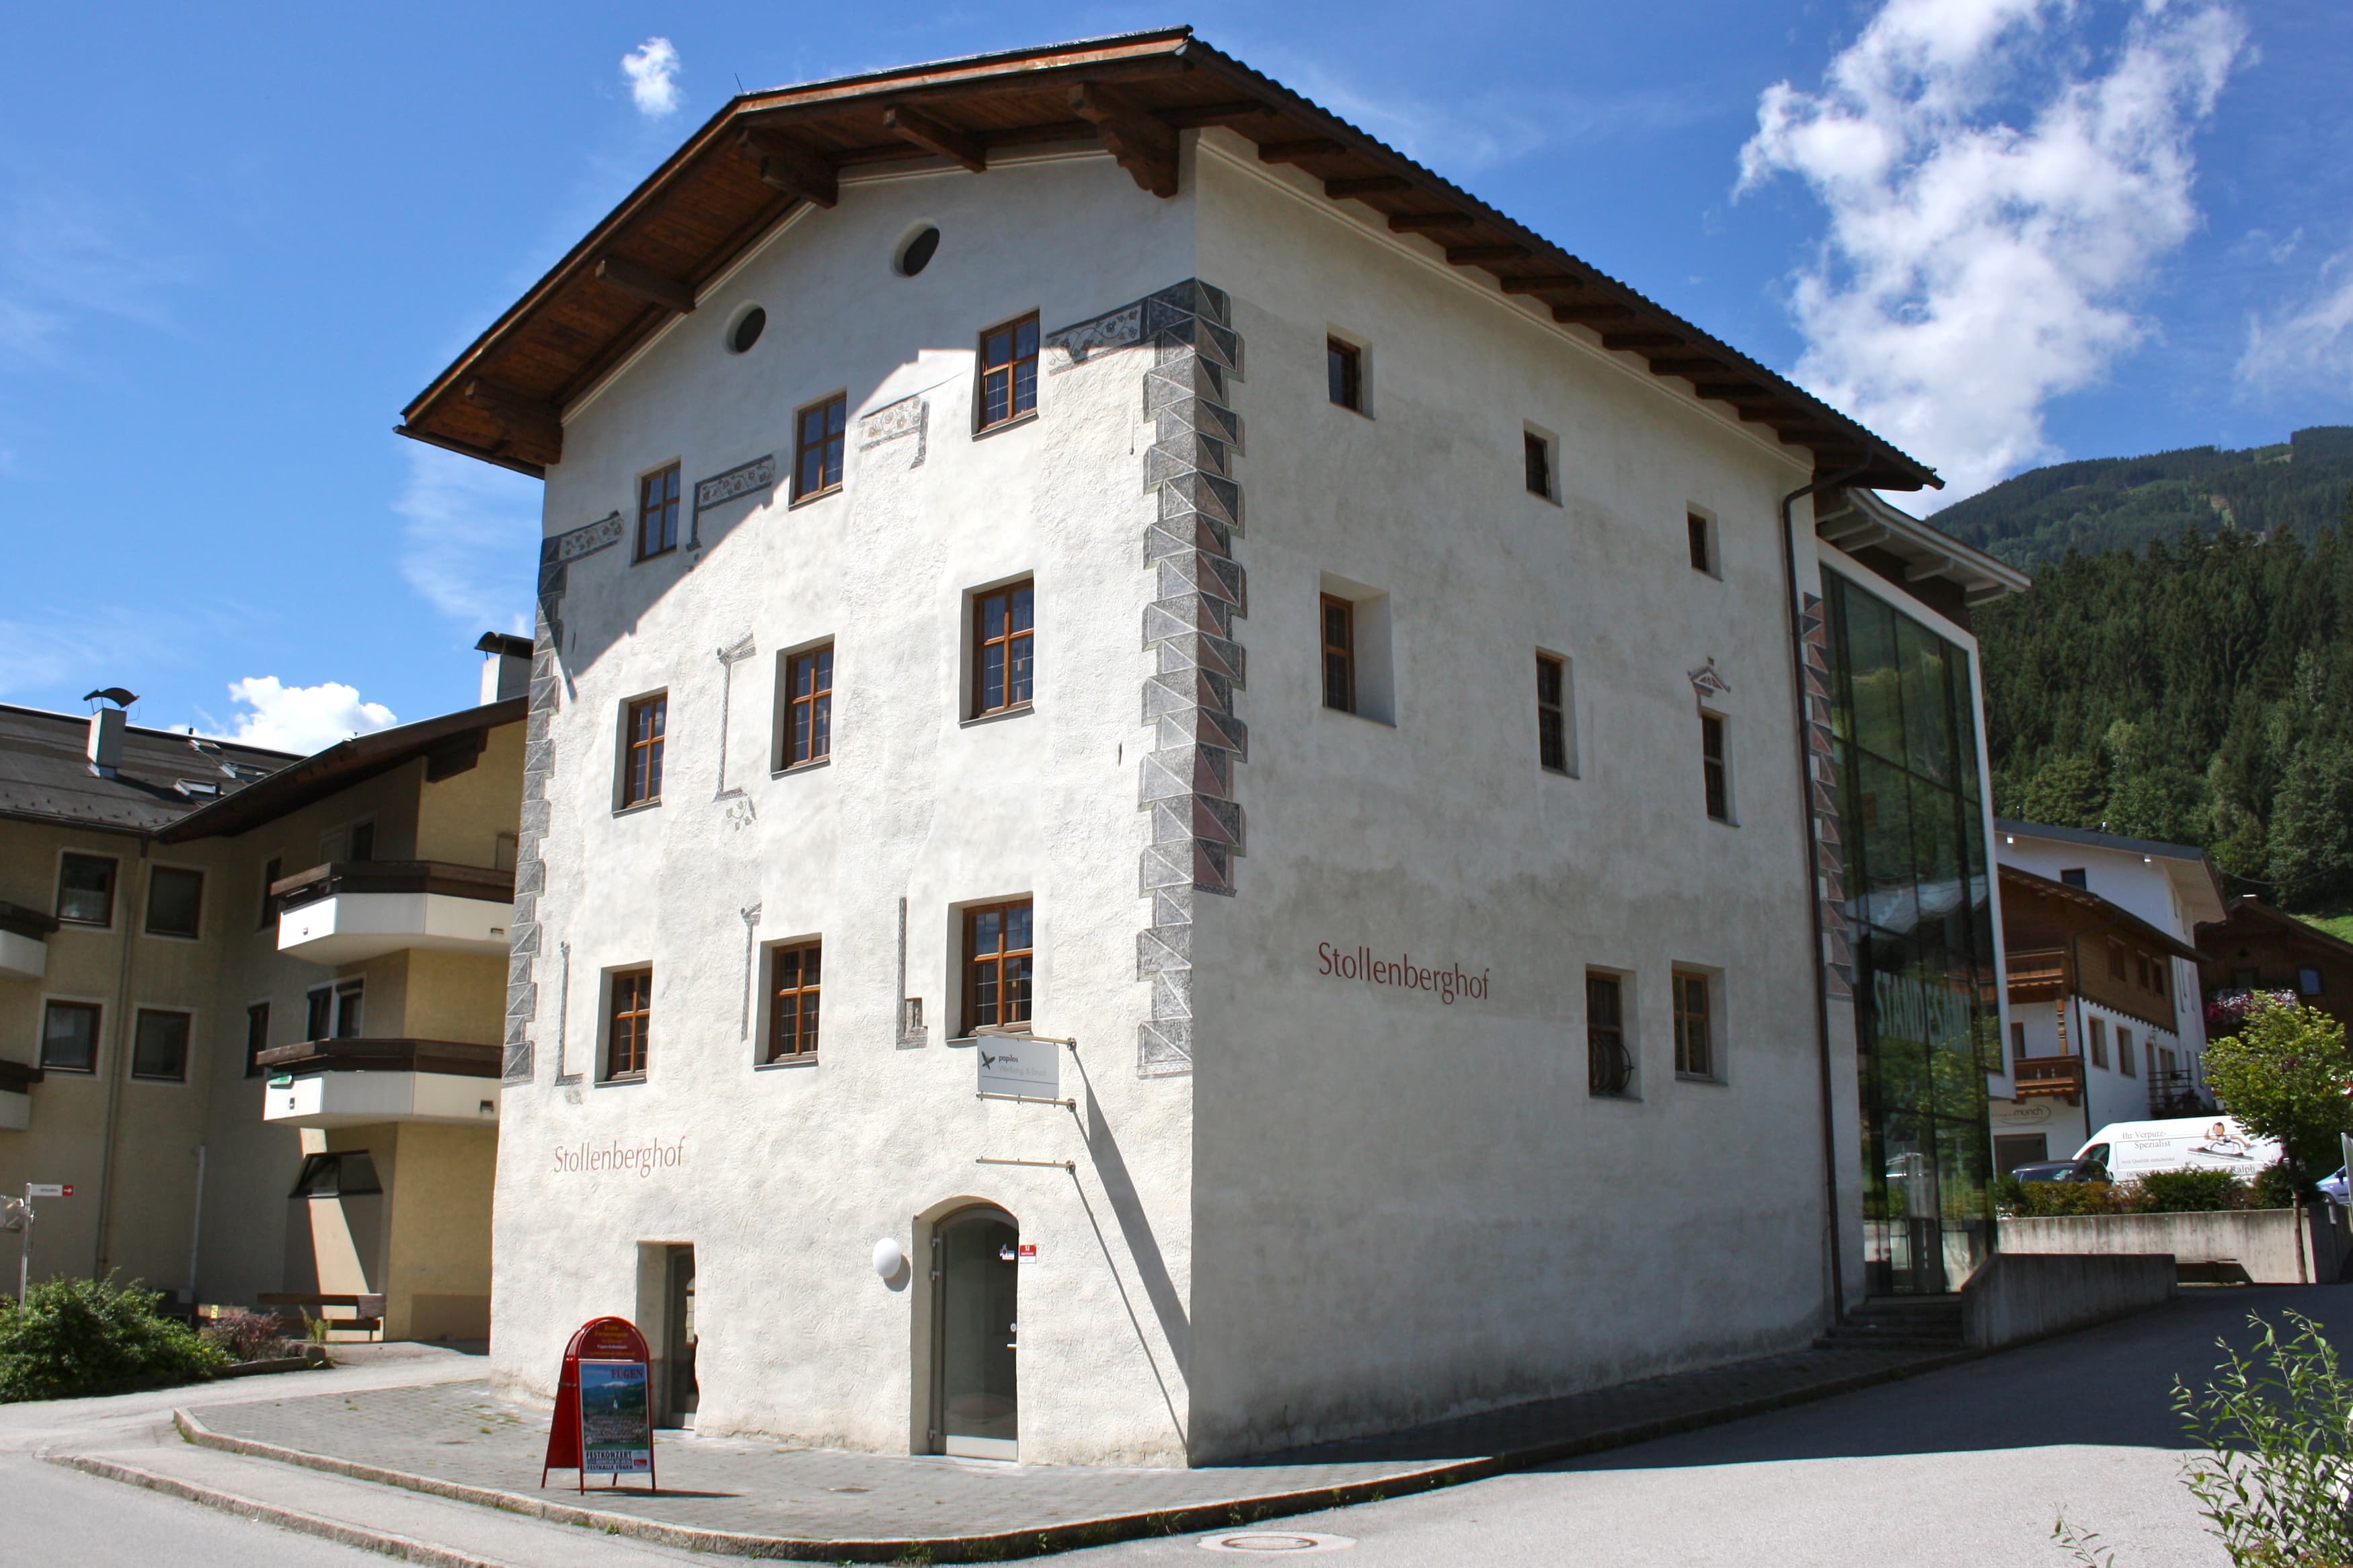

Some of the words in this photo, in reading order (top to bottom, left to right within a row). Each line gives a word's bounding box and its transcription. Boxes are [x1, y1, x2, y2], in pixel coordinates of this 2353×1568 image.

[1318, 941, 1490, 1005] Stollenberghof
[1874, 969, 1973, 1054] STANDESAMT
[998, 1054, 1019, 1064] papilos
[2122, 1132, 2132, 1140] Ihr
[2134, 1130, 2167, 1140] Verputz-
[2134, 1140, 2171, 1150] Spezialist
[554, 1136, 686, 1178] Stollenberghof
[2229, 1164, 2255, 1174] Ralph
[611, 1366, 643, 1379] FÜGEN
[586, 1450, 632, 1459] FESTKONZERT
